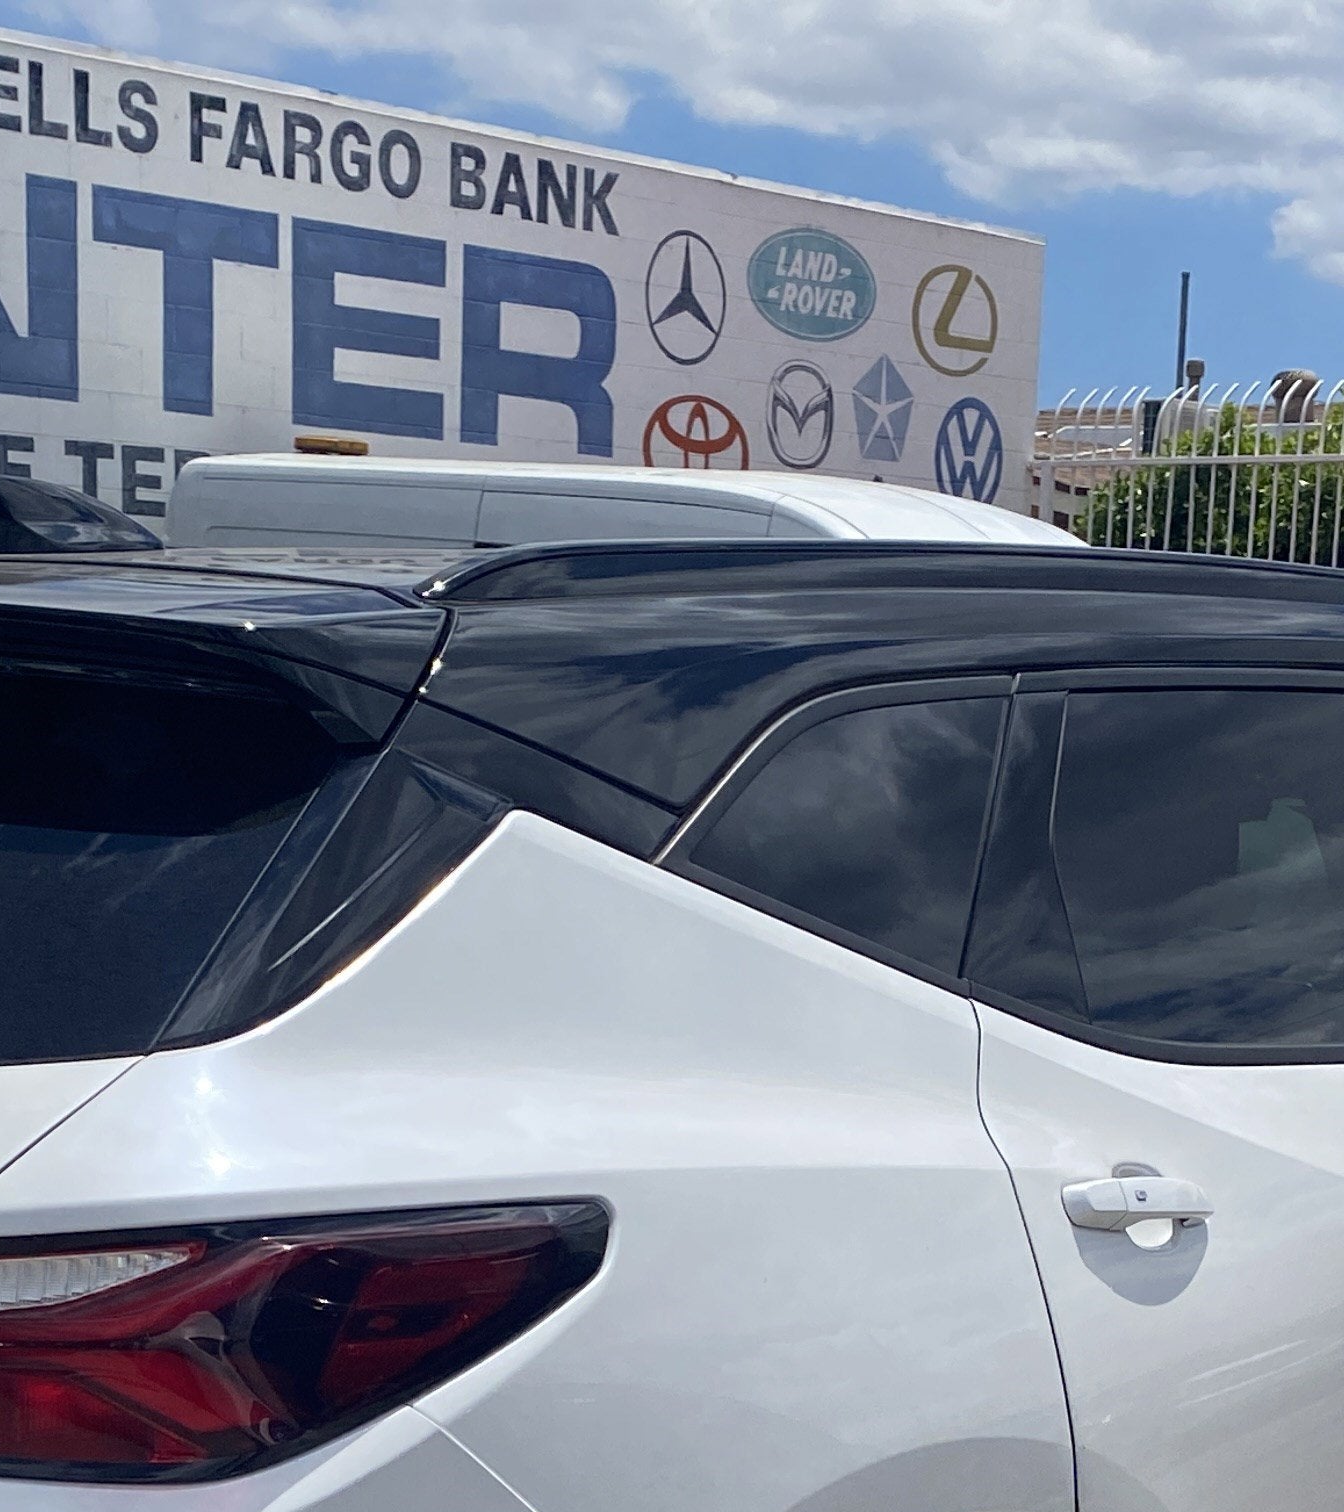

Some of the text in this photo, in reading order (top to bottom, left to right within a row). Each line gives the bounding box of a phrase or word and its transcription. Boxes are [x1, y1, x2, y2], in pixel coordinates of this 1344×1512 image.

[190, 91, 421, 198] FARGO
[450, 142, 620, 236] BANK
[780, 282, 856, 320] ROVER
